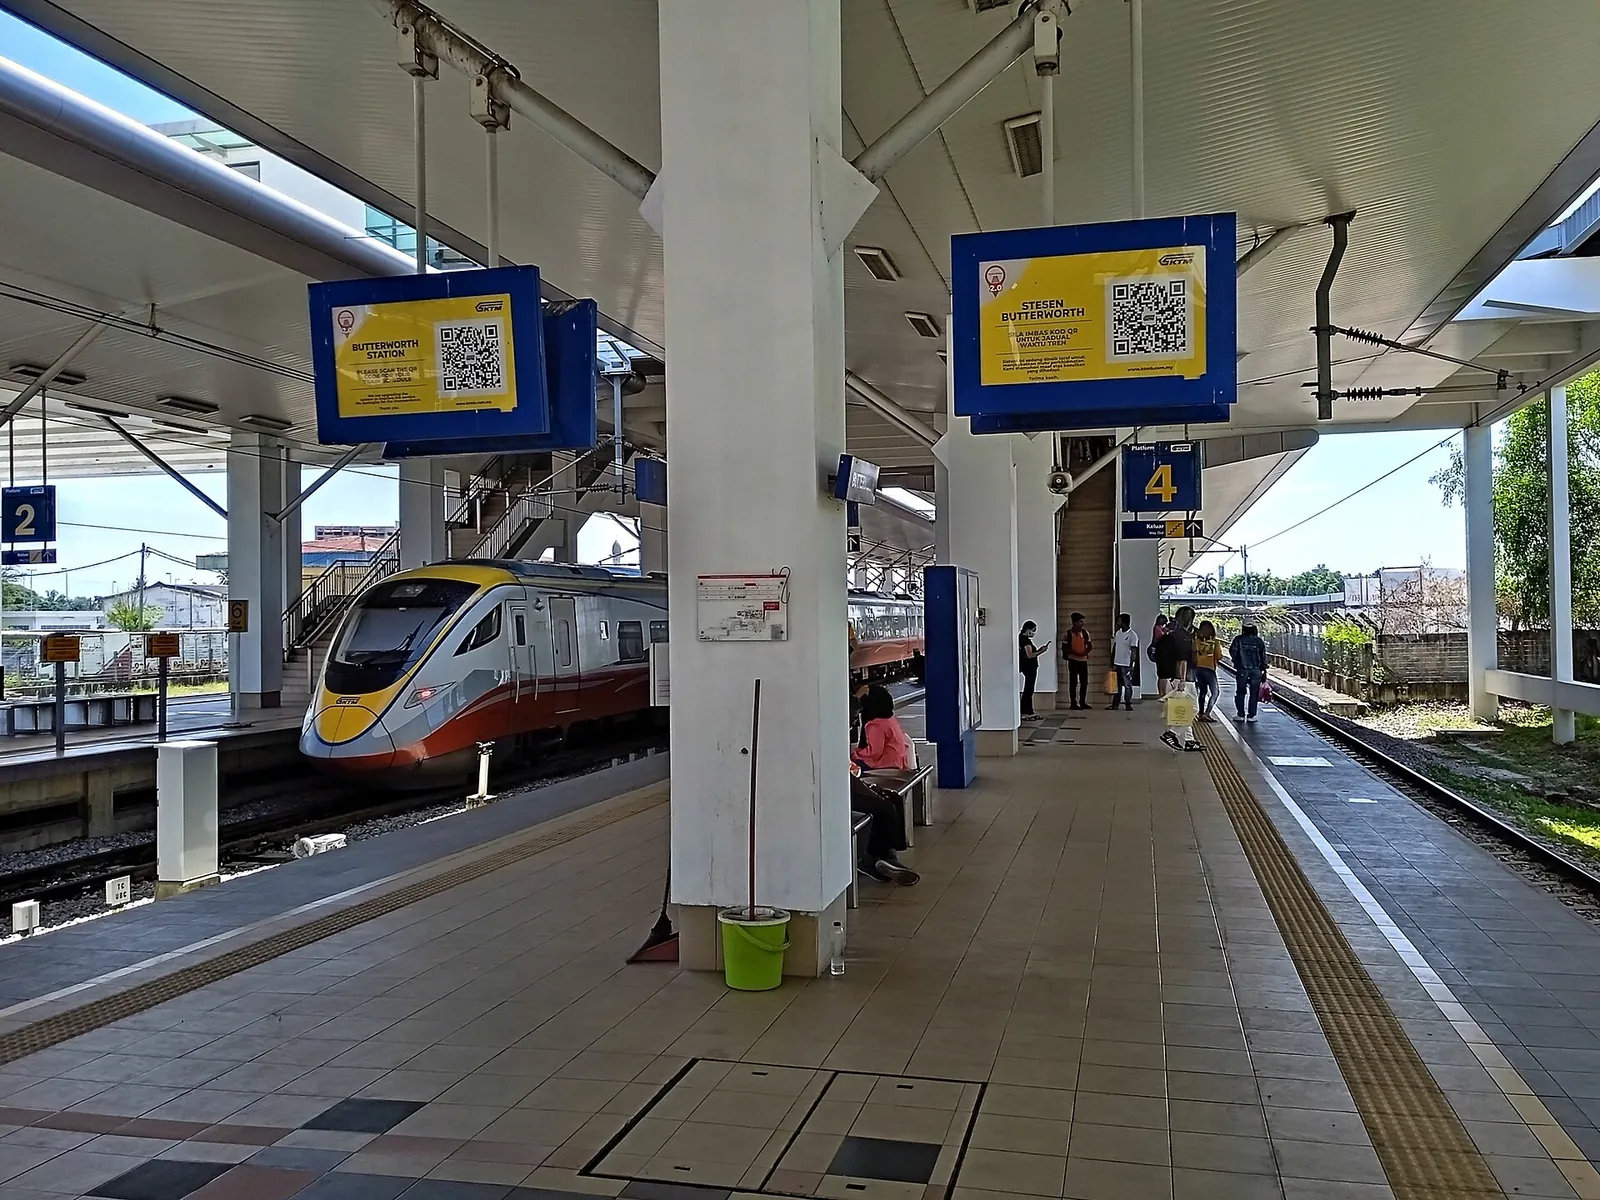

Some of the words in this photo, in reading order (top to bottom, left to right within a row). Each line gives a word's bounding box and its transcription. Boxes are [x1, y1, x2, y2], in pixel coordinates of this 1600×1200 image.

[989, 284, 1003, 292] 2.0
[1021, 299, 1064, 311] STESEN
[1001, 307, 1085, 322] BUTTERWORTH
[1016, 335, 1041, 343] UNTUK
[1041, 333, 1071, 342] JADUAL
[1025, 329, 1049, 337] IMBAS
[1049, 327, 1066, 335] KOD
[1067, 327, 1079, 335] QR
[351, 339, 419, 352] BUTTERWORTH
[1019, 341, 1046, 349] WAKTU
[1047, 339, 1067, 347] TREN
[366, 349, 405, 360] STATION
[1145, 464, 1177, 503] 4
[15, 503, 35, 536] 2
[231, 602, 243, 619] 6
